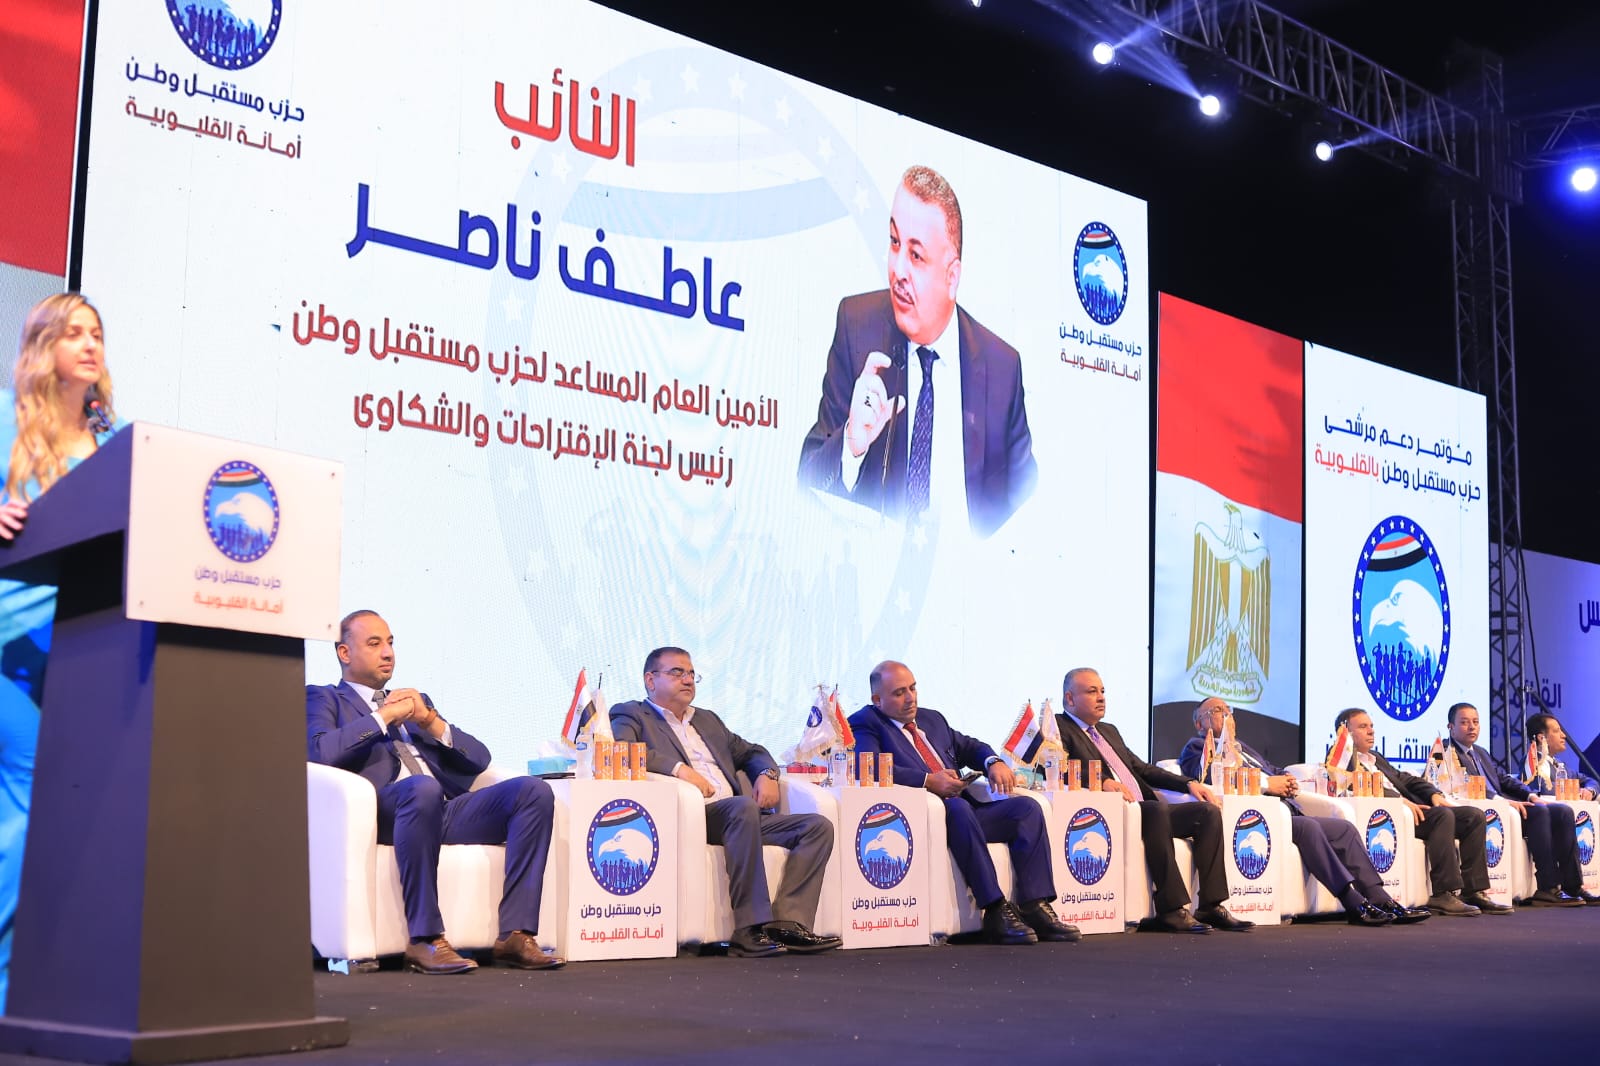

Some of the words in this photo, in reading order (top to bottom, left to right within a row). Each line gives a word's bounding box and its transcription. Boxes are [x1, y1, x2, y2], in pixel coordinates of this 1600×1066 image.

[126, 56, 179, 92] وطن
[184, 73, 264, 112] مستقبل
[125, 95, 232, 142] القليوبية
[268, 99, 305, 122] حزب
[494, 68, 636, 168] النائب
[236, 124, 302, 159] أمانة
[346, 182, 541, 281] ناصر
[558, 228, 745, 332] عاطف
[293, 299, 361, 355] وطن
[1059, 321, 1085, 344] وطن
[1086, 329, 1124, 352] مستقبل
[369, 317, 480, 373] مستقبل
[1125, 341, 1142, 357] حزب
[488, 345, 547, 387] لحزب
[1060, 348, 1110, 373] القليوبية
[1111, 361, 1142, 381] أمانة
[554, 360, 647, 403] المساعد
[653, 379, 710, 415] العام
[715, 388, 778, 429] الأمين
[353, 389, 489, 448] والشكاوى
[497, 410, 616, 470] الإقتراحات
[1379, 429, 1413, 449] دعم
[1416, 438, 1472, 466] مؤتمر
[623, 432, 672, 477] لجنة
[678, 446, 733, 488] رئيس
[1315, 443, 1379, 482] بالقليوبية
[1382, 459, 1409, 488] وطن
[1412, 467, 1456, 496] مستقبل
[1458, 480, 1481, 503] حزب
[852, 897, 870, 910] وطن
[871, 896, 901, 910] مستقبل
[902, 896, 917, 908] حزب
[1061, 892, 1076, 904] وطن
[1076, 891, 1101, 904] مستقبل
[1102, 890, 1115, 902] حزب
[580, 904, 602, 919] وطن
[604, 903, 641, 918] مستقبل
[643, 903, 662, 918] حزب
[852, 917, 893, 931] القليوبية
[580, 927, 630, 943] القليوبية
[632, 924, 664, 939] أمانة
